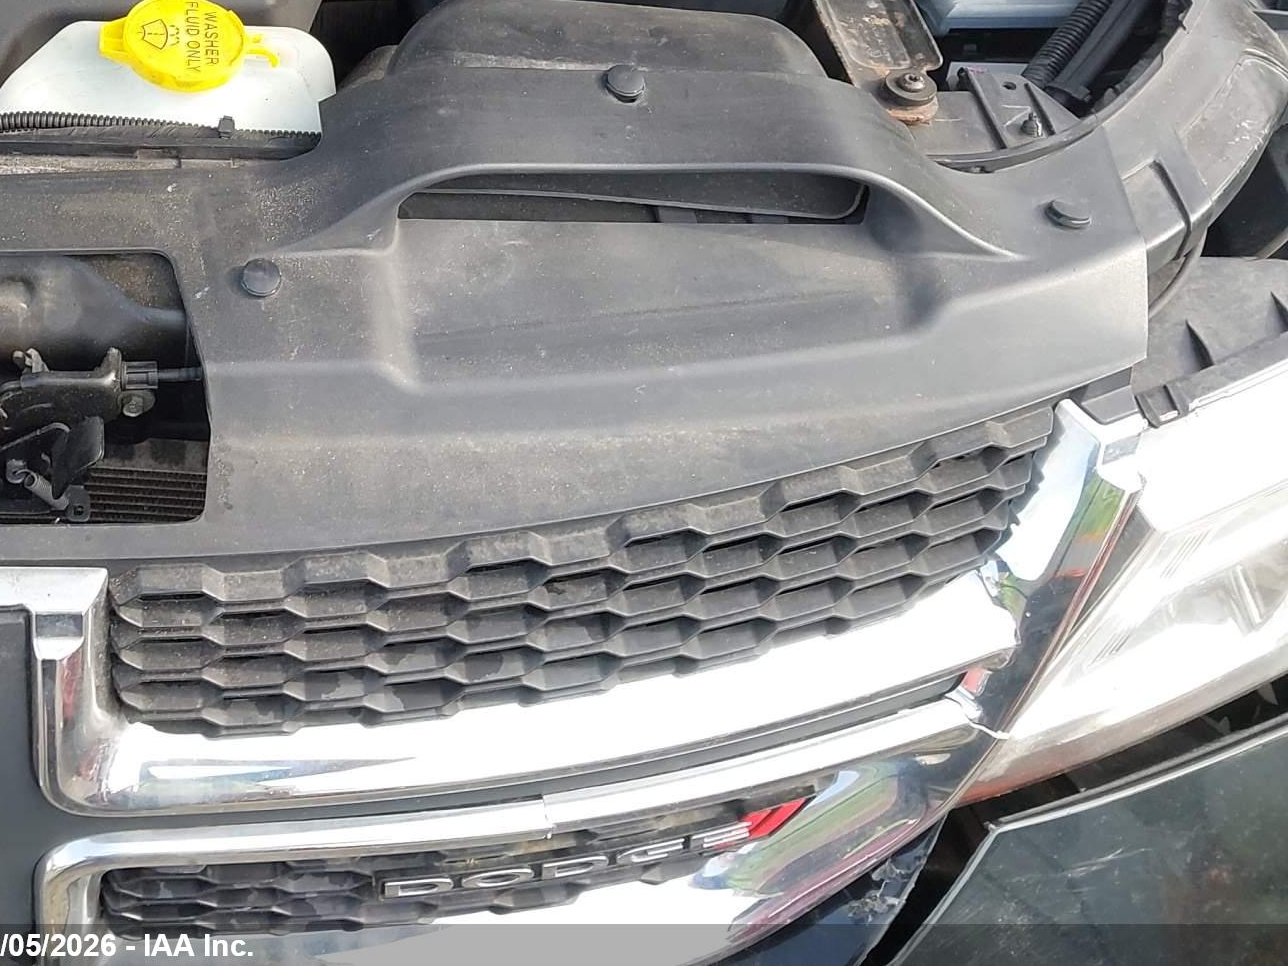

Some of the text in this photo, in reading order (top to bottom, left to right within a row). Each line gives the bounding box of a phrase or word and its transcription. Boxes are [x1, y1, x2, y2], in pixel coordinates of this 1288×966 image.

[185, 1, 202, 73] FLUID ONLY
[204, 11, 220, 66] WASHER
[381, 820, 751, 899] DODGE
